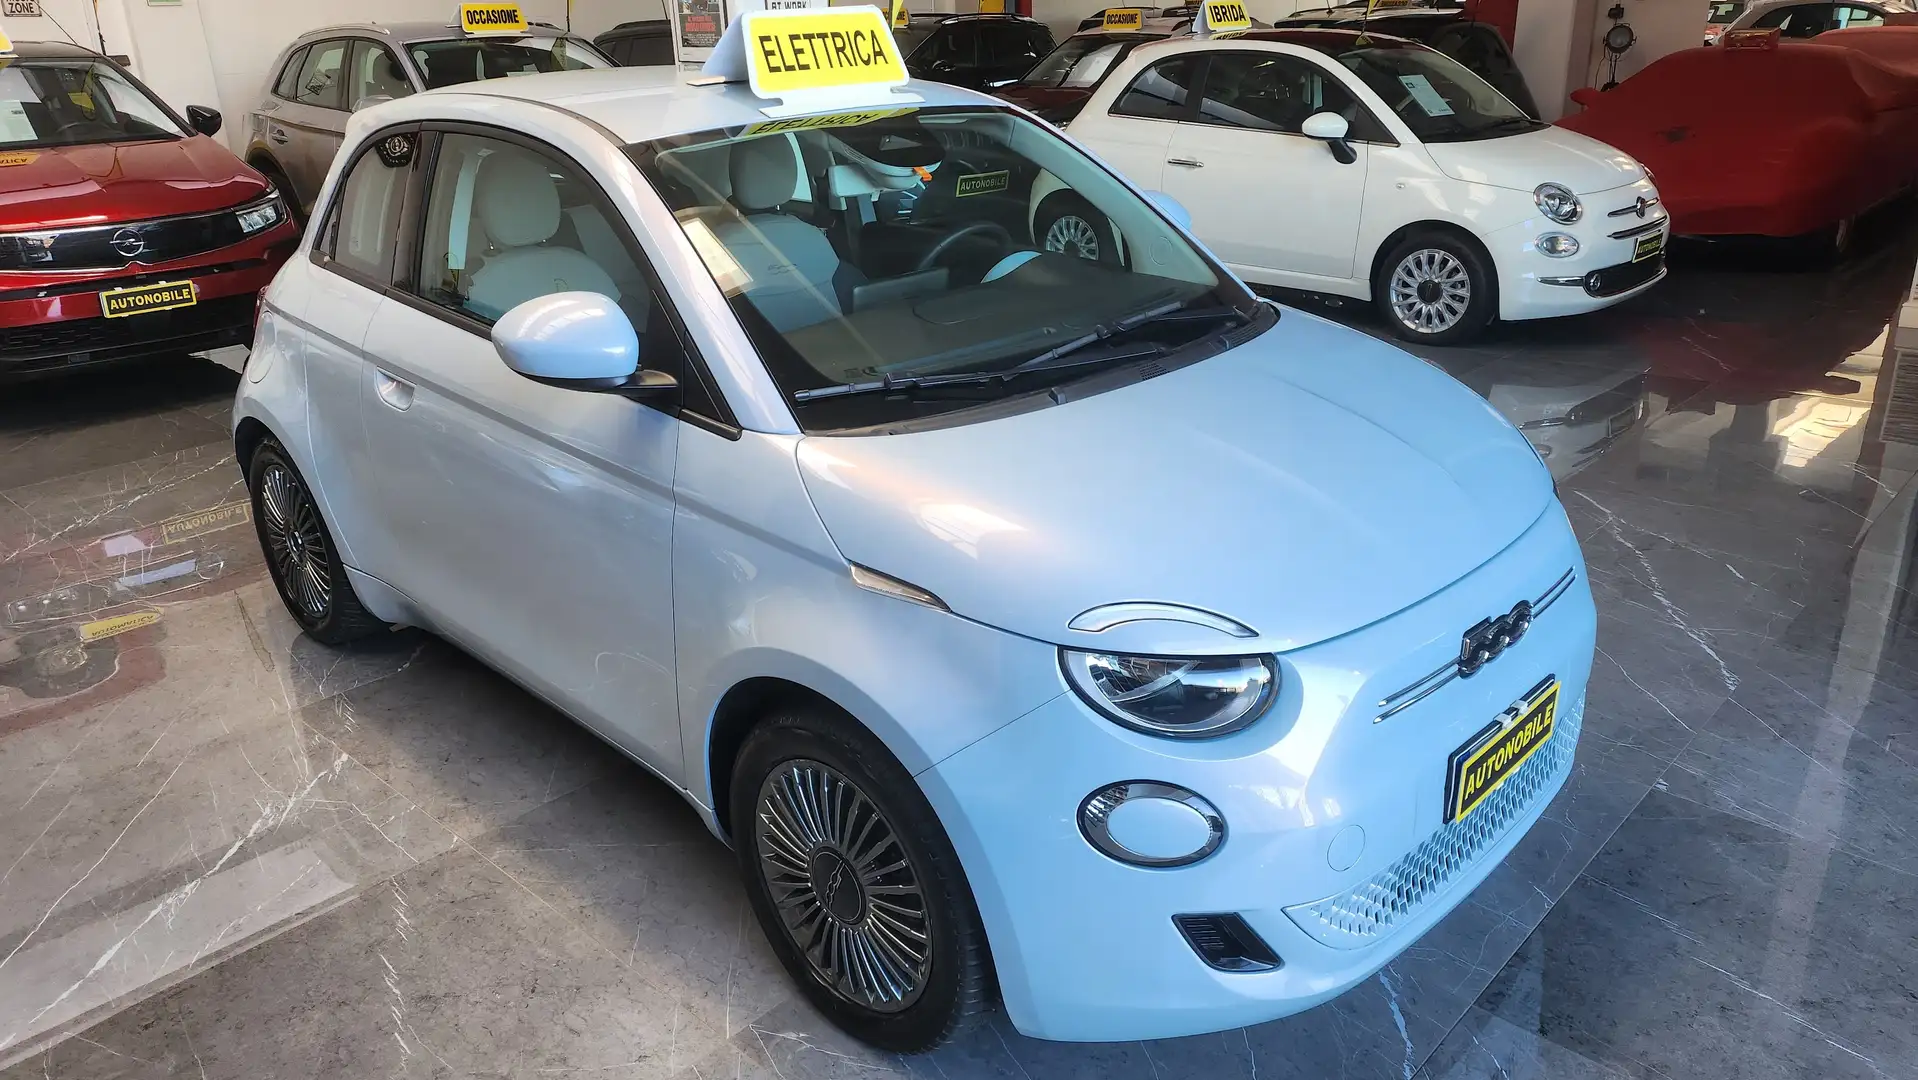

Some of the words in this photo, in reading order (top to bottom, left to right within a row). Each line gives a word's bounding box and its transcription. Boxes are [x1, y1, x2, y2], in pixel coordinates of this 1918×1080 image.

[8, 3, 35, 13] ZONE
[784, 1, 807, 10] WORK
[1208, 4, 1247, 23] IBRIDA
[466, 9, 519, 25] OCCASIONE
[1106, 13, 1138, 25] OCCASIONE
[758, 29, 889, 73] ELETTRICA
[960, 176, 1006, 191] AUTONOBILE
[109, 288, 192, 311] AUTONOBILE
[1465, 701, 1555, 801] AUTONOBILE
